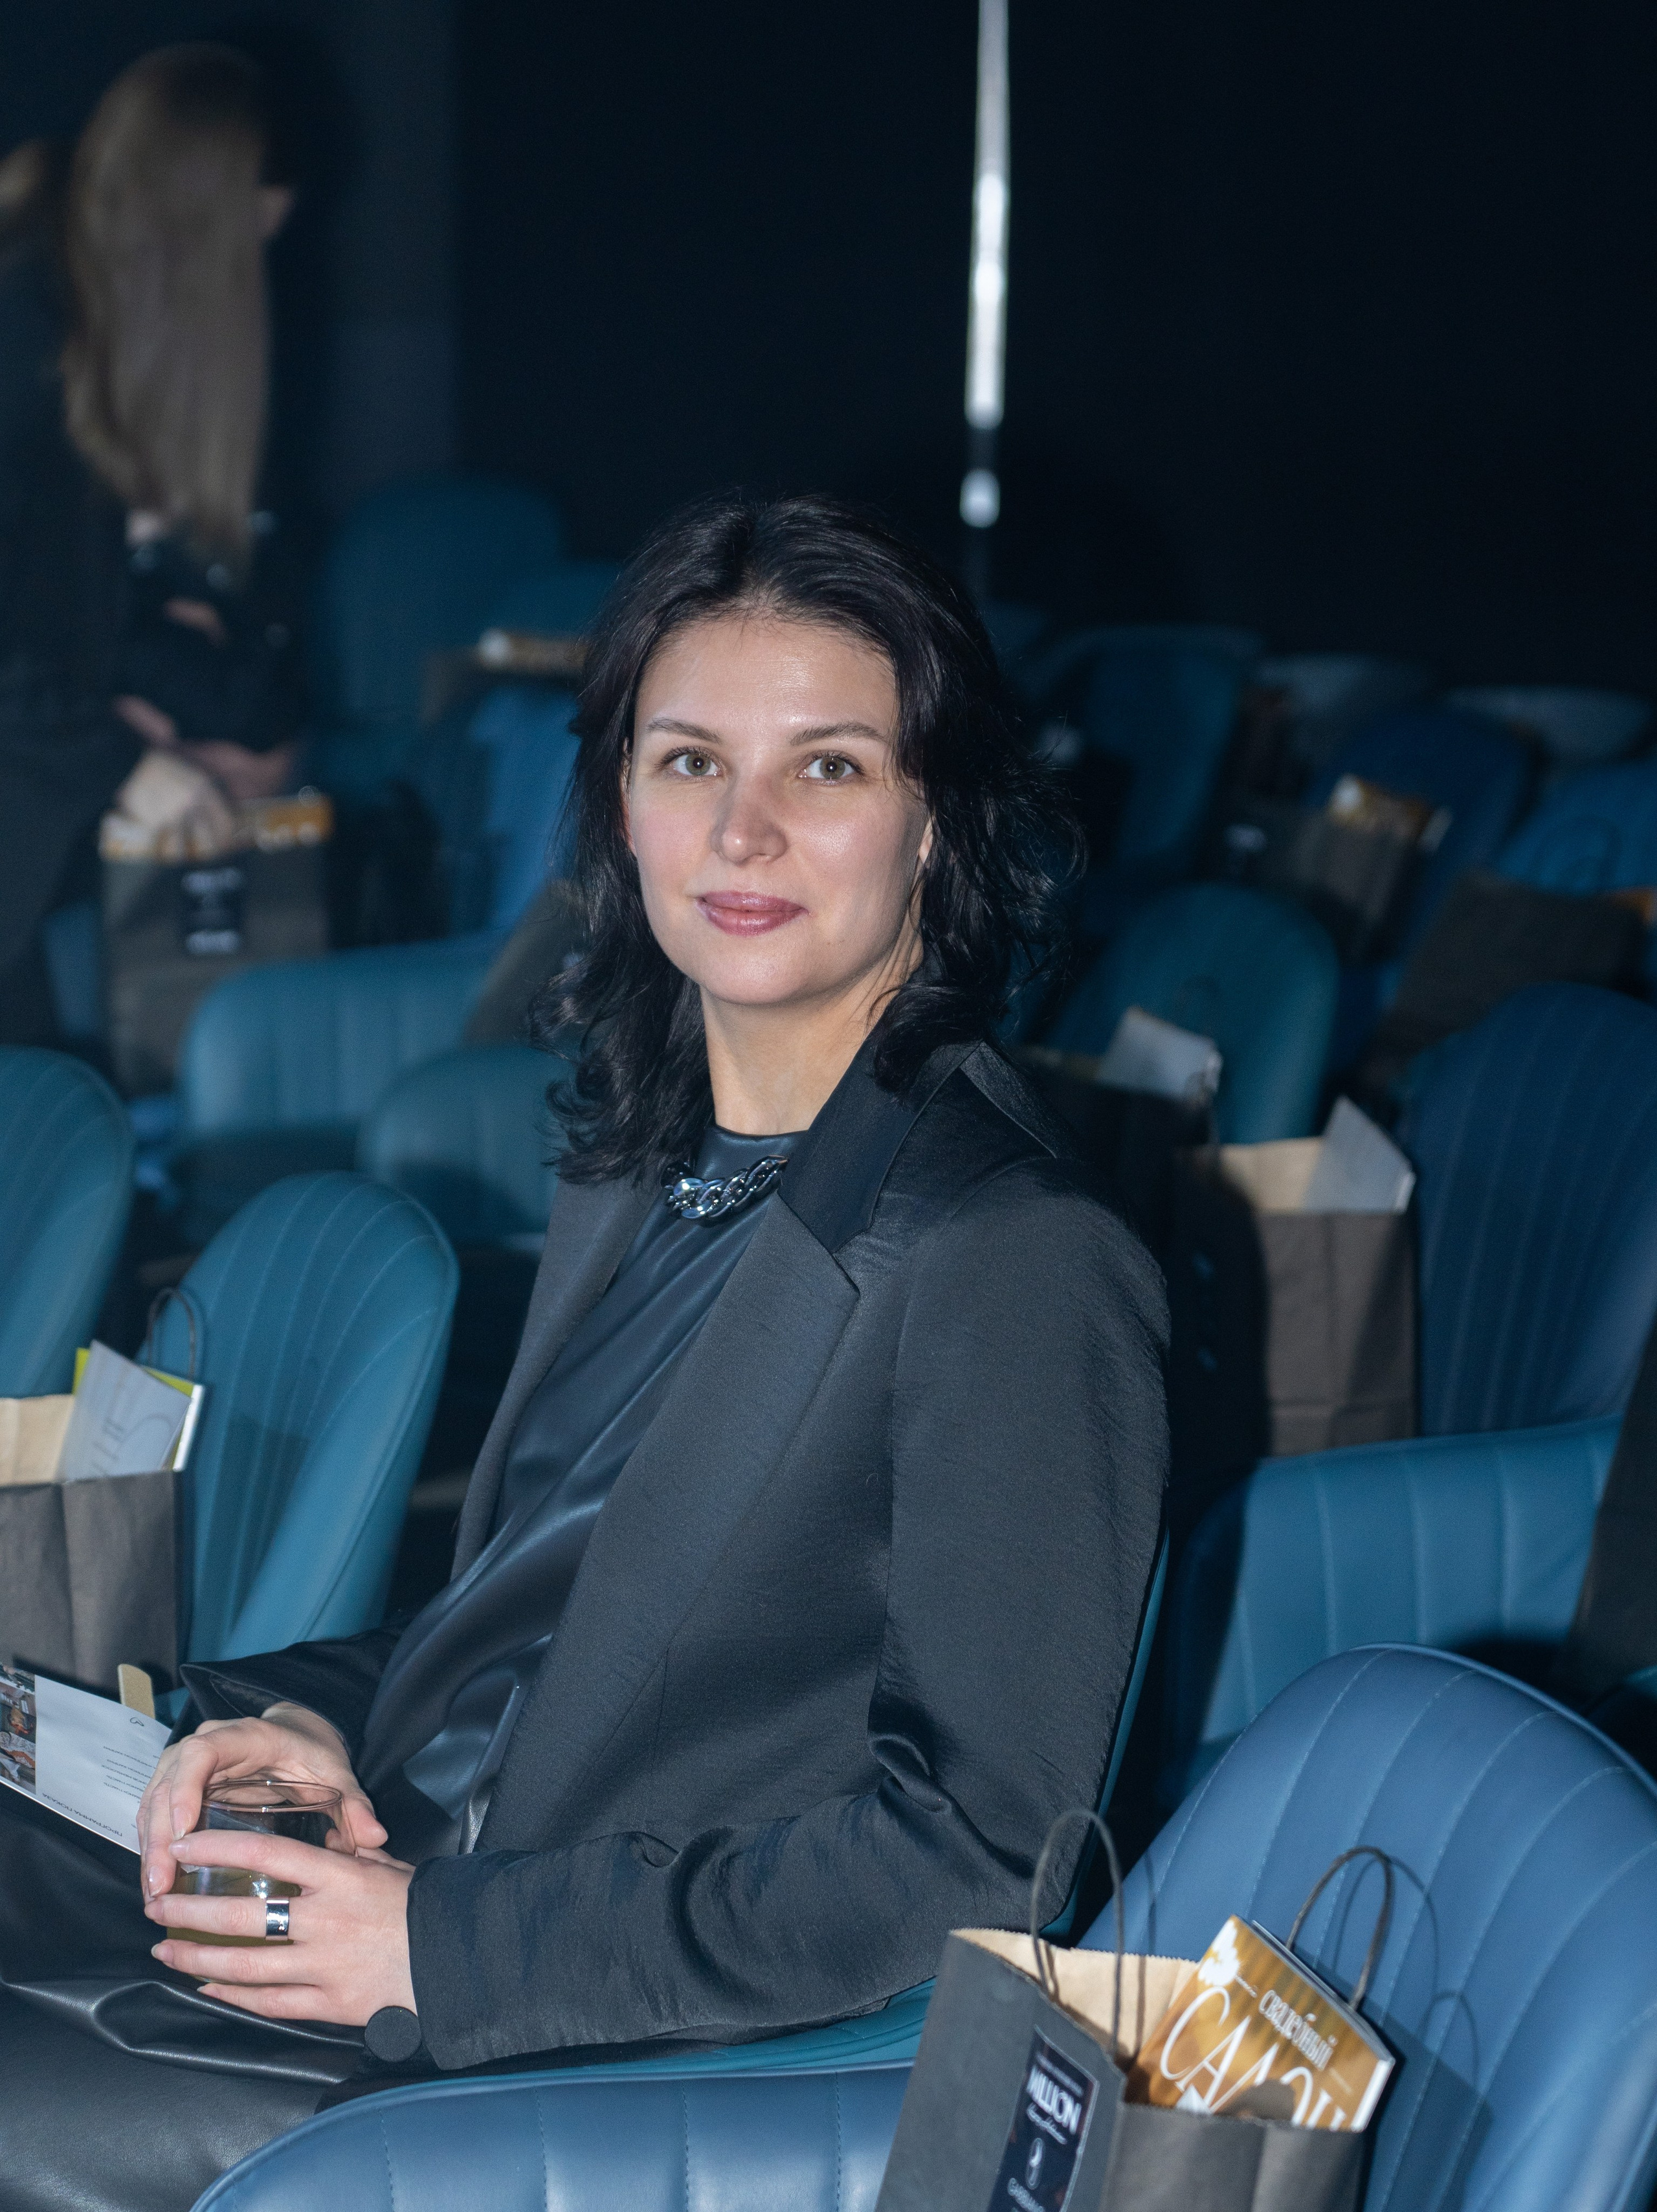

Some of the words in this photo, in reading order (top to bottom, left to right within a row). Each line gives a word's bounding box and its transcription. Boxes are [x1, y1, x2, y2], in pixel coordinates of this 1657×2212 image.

[42, 1793, 73, 1813] ПОКАЗА
[74, 1809, 123, 1837] ПРОГРАММА
[1259, 1989, 1339, 2072] свадебный
[1026, 2065, 1082, 2135] MILLION
